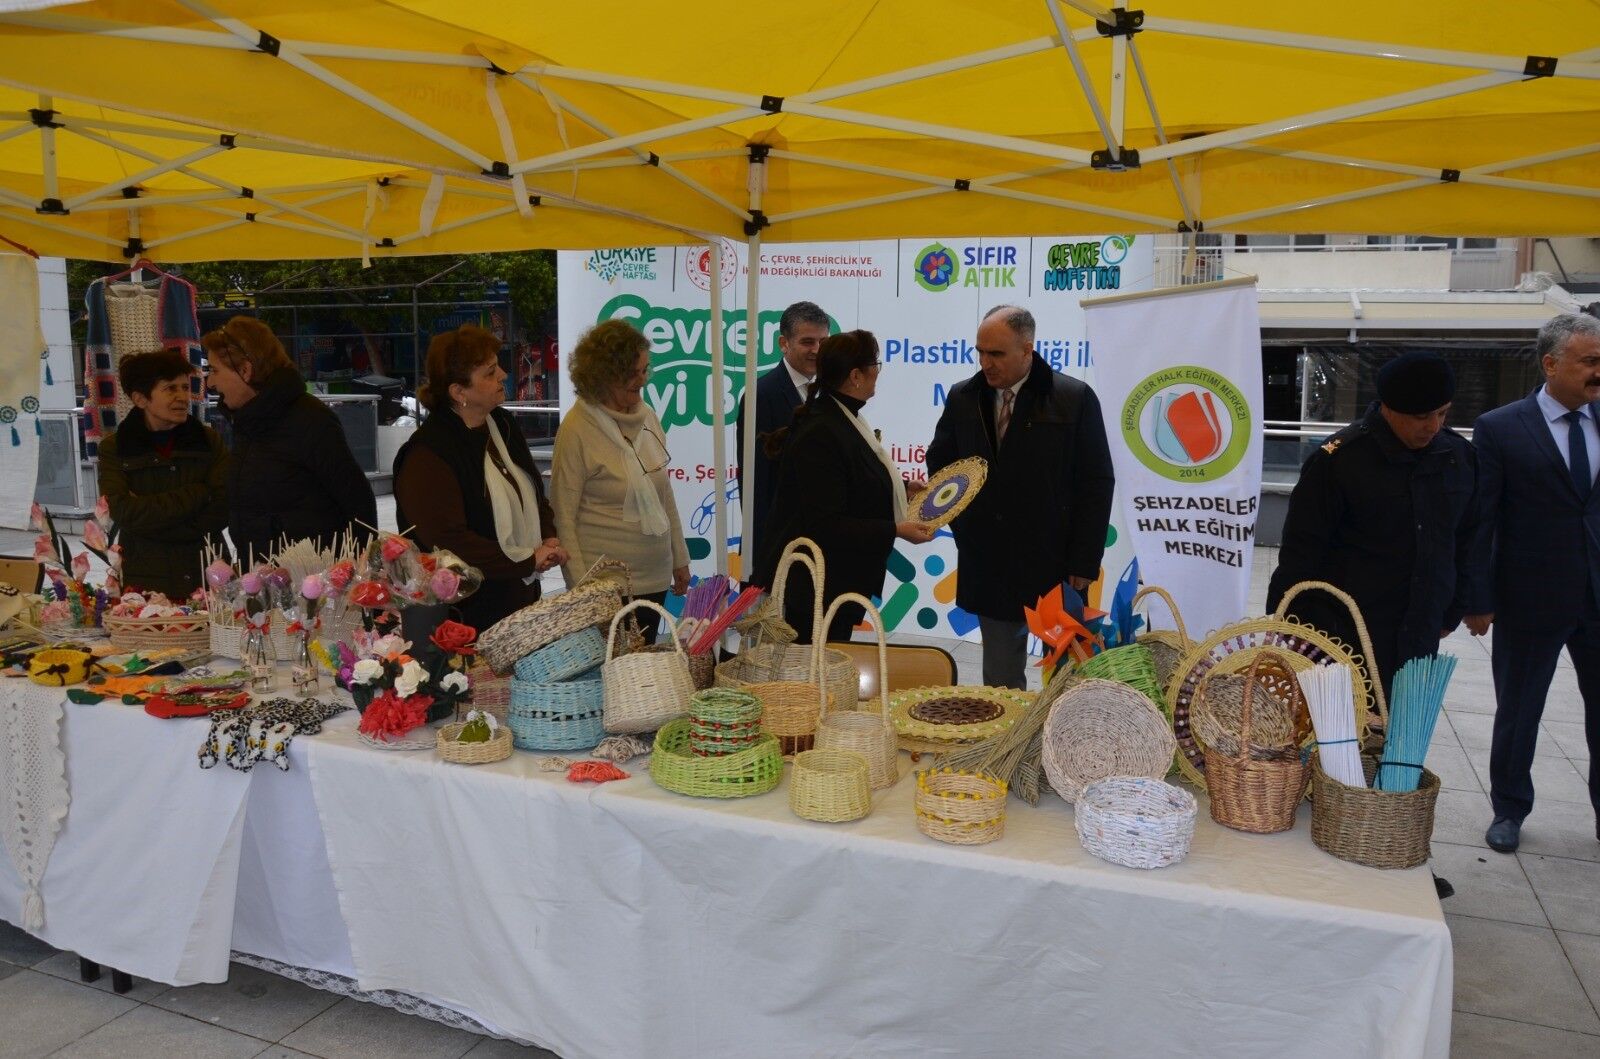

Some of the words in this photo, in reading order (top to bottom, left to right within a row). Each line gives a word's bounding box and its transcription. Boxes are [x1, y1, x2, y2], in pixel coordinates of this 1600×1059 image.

[771, 255, 804, 265] ÇEVRE,
[806, 254, 858, 266] ŞEHİRCİLİK
[860, 256, 872, 265] VE
[964, 246, 1016, 265] SIFIR
[1048, 242, 1100, 269] ÇEVRE
[623, 263, 649, 273] ÇEVRE
[623, 271, 656, 280] HAFTASI
[771, 267, 827, 279] DEĞİŞİKLİĞİ
[830, 268, 882, 278] BAKANLIĞI
[963, 267, 1016, 287] ATIK
[885, 338, 974, 364] Plastik
[1077, 340, 1095, 368] il
[1126, 381, 1157, 431] ŞEHZADELER
[1157, 371, 1182, 384] HALK
[1186, 370, 1221, 388] EĞİTİMİ
[1220, 384, 1247, 420] MERKEZİ
[1179, 468, 1206, 478] 2014
[1133, 496, 1257, 516] ŞEHZADELER
[1137, 518, 1191, 533] HALK
[1165, 540, 1243, 568] MERKEZİ
